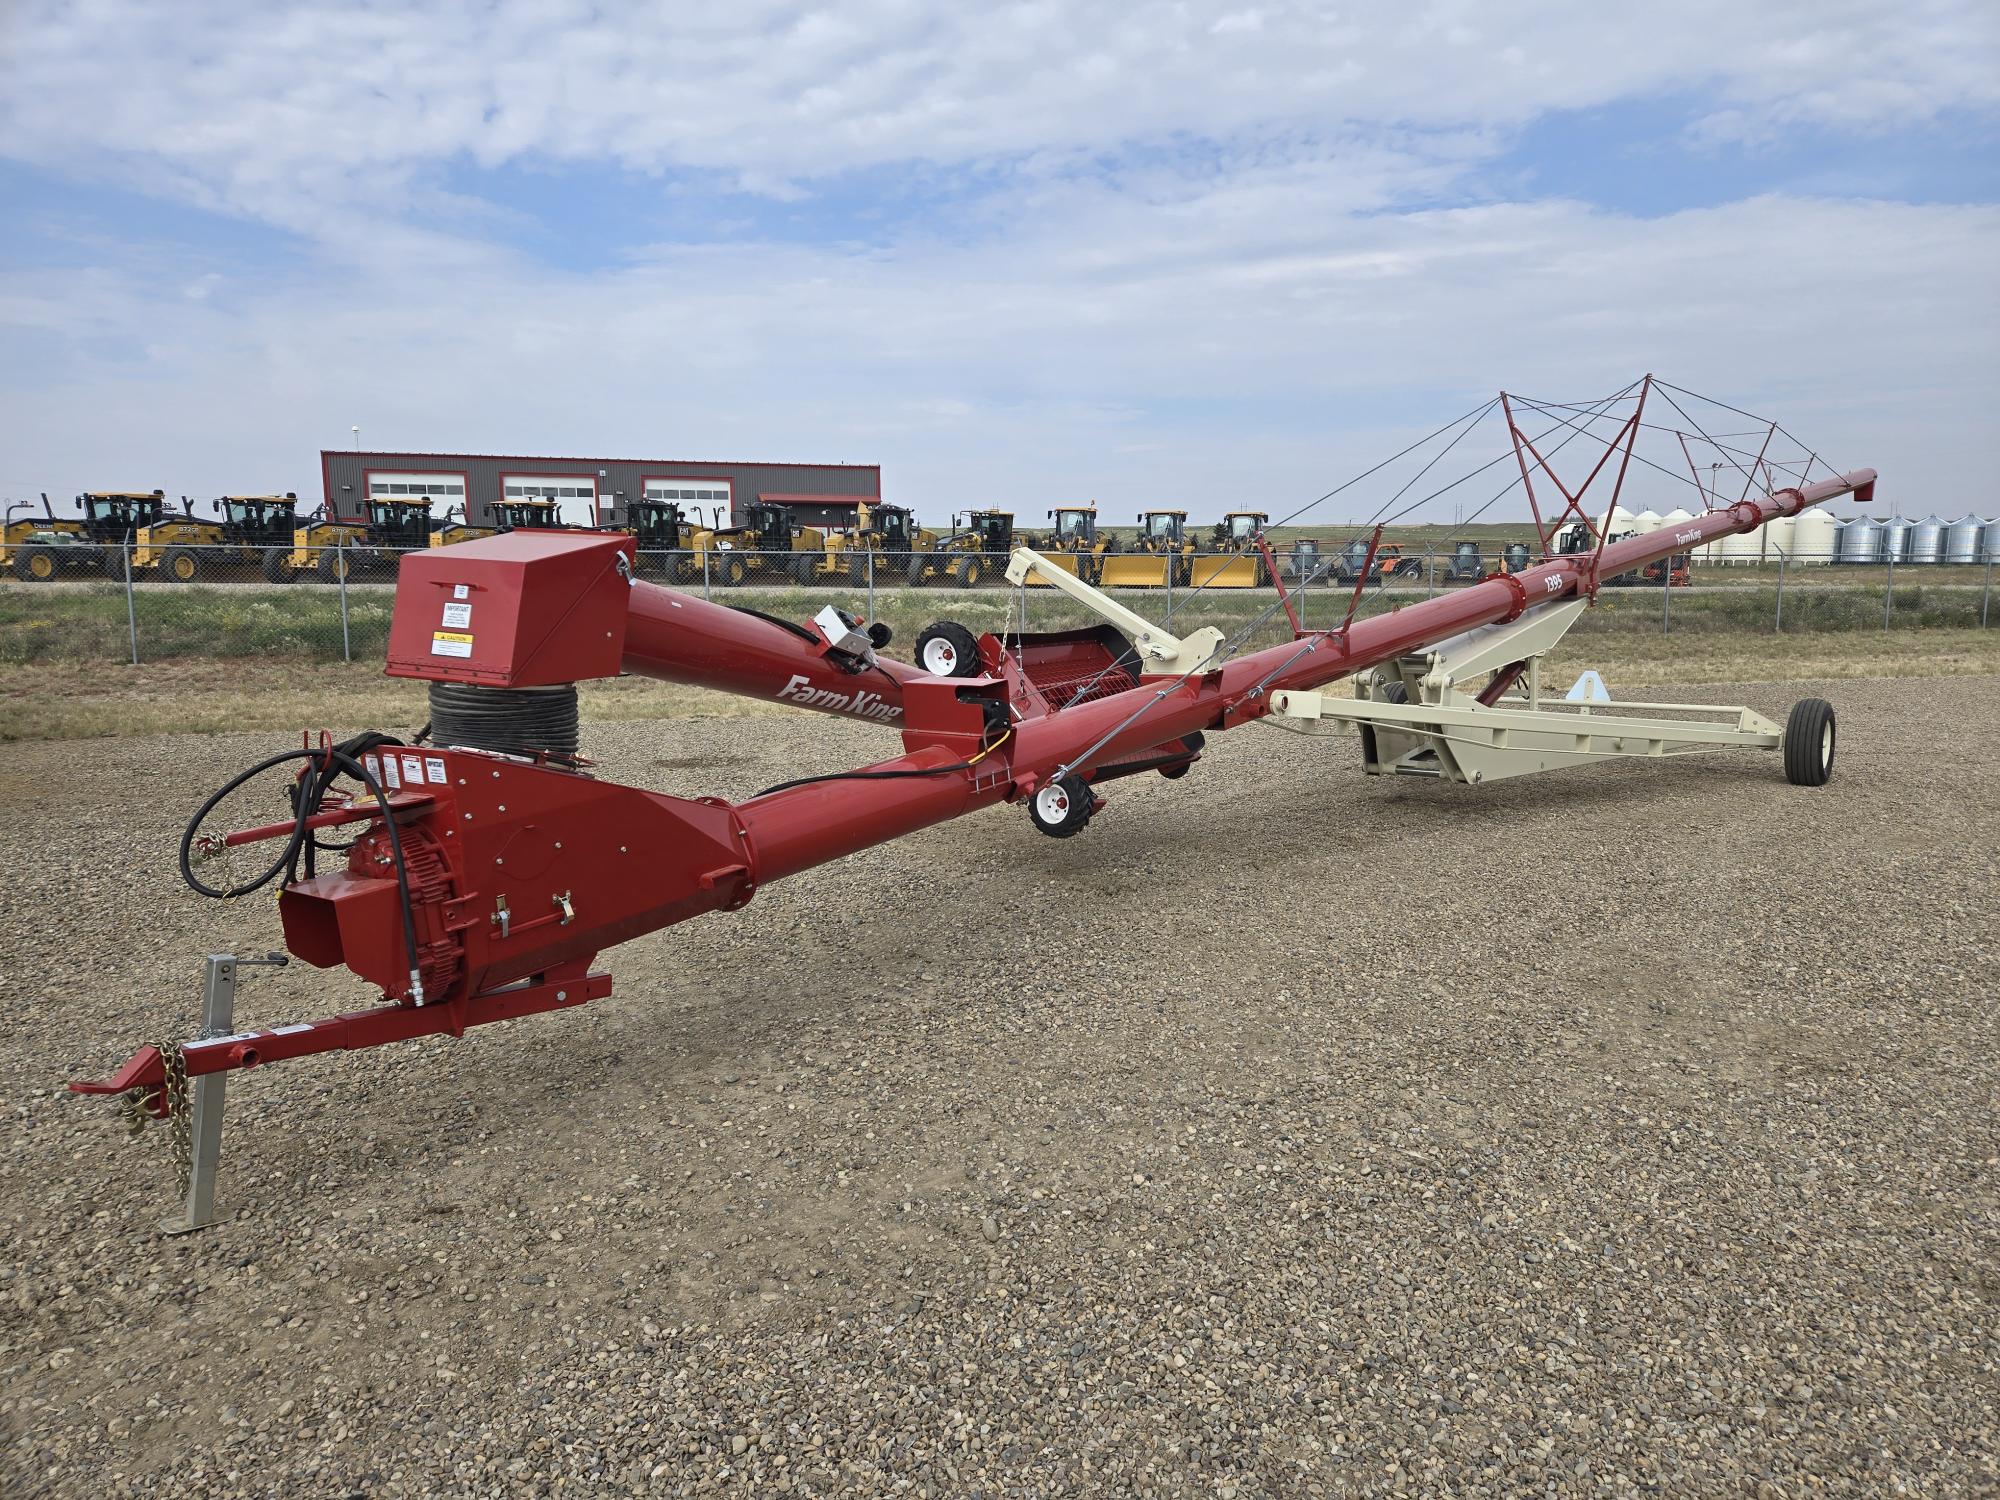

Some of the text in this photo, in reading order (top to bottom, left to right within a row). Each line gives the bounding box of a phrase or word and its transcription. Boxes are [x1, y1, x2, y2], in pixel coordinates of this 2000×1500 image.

[1544, 574, 1563, 592] 1395
[446, 634, 467, 642] CAUTION
[776, 674, 904, 722] Farm King
